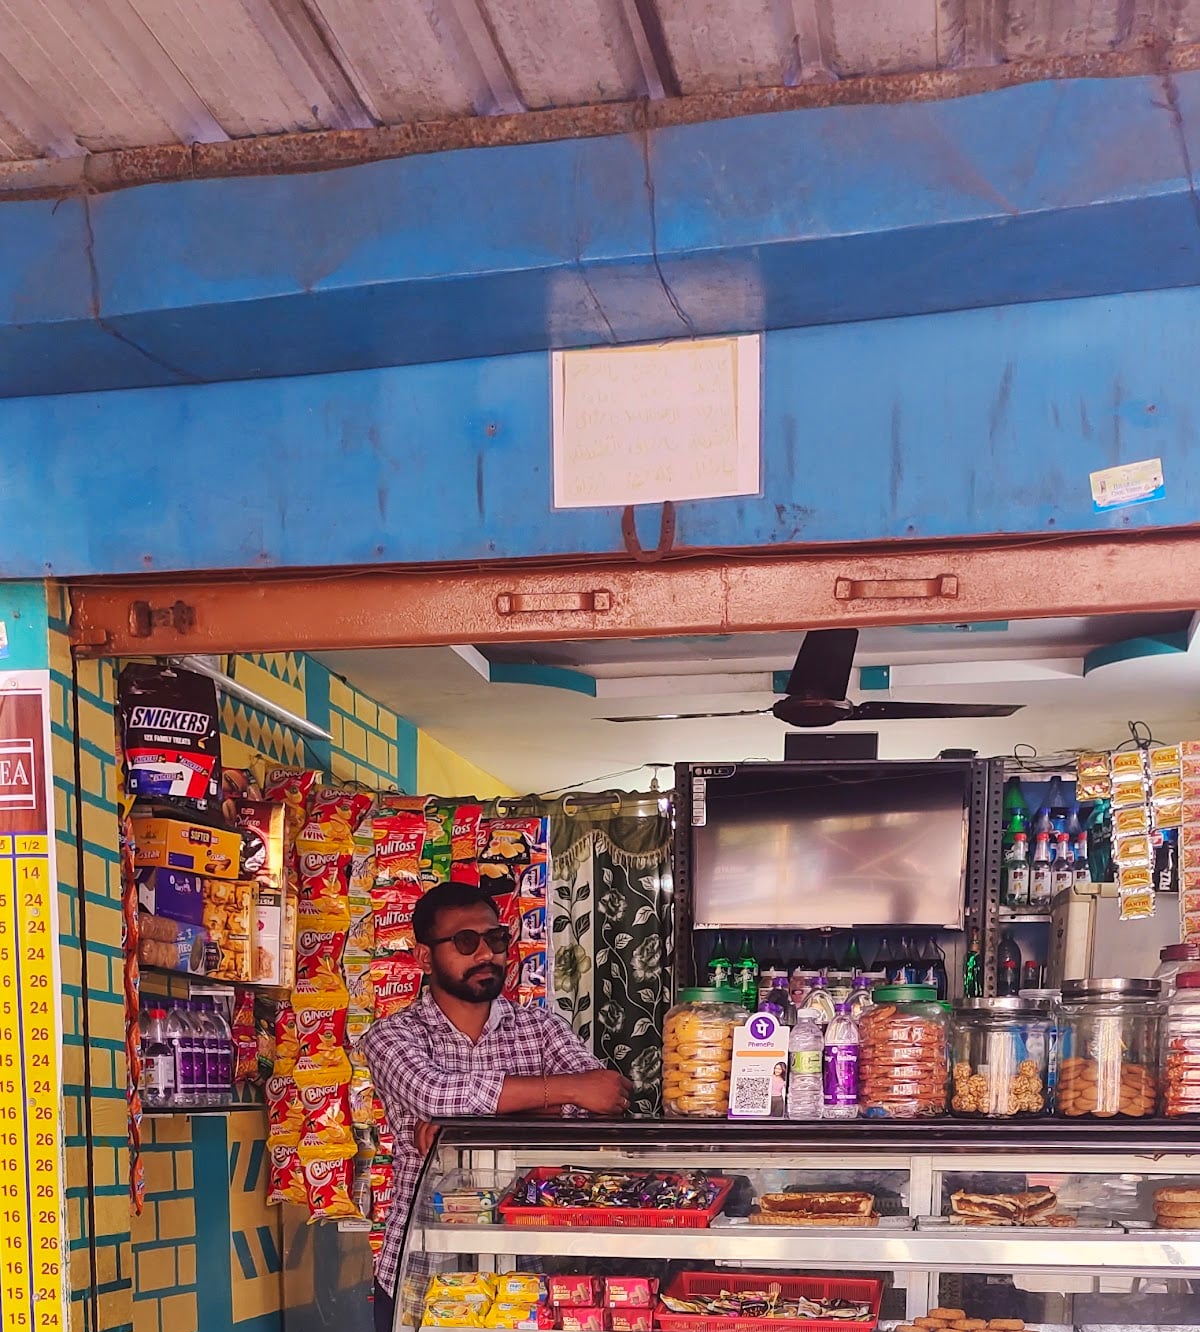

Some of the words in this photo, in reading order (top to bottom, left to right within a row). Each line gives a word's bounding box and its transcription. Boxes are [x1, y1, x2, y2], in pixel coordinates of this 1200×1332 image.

[132, 708, 208, 733] SNICKERS
[22, 840, 40, 851] 1/2
[375, 840, 416, 857] FullToss
[308, 852, 339, 867] BINGO!
[23, 867, 40, 879] 14
[24, 894, 44, 907] 24
[27, 921, 46, 934] 24
[303, 931, 334, 946] BINGO!
[27, 948, 46, 961] 24
[29, 975, 48, 988] 26
[374, 981, 413, 997] FullToss
[29, 1002, 49, 1015] 24
[303, 1008, 335, 1023] BINGO!
[31, 1028, 49, 1041] 26
[31, 1054, 50, 1067] 24
[0, 1081, 15, 1094] 15
[33, 1081, 52, 1094] 24
[307, 1083, 338, 1101] BINGO!
[0, 1107, 17, 1120] 16
[35, 1107, 53, 1120] 26
[0, 1133, 18, 1146] 16
[35, 1133, 54, 1146] 26
[0, 1159, 18, 1172] 16
[35, 1159, 54, 1172] 26
[312, 1158, 343, 1175] BINGO!
[0, 1185, 18, 1198] 16
[36, 1185, 54, 1198] 26
[3, 1211, 21, 1223] 16
[38, 1211, 57, 1224] 26
[5, 1237, 22, 1249] 16
[40, 1237, 58, 1250] 26
[6, 1262, 23, 1275] 16
[41, 1263, 59, 1276] 26
[6, 1288, 24, 1300] 15
[39, 1288, 57, 1301] 24
[9, 1313, 27, 1326] 15
[41, 1314, 59, 1326] 24
